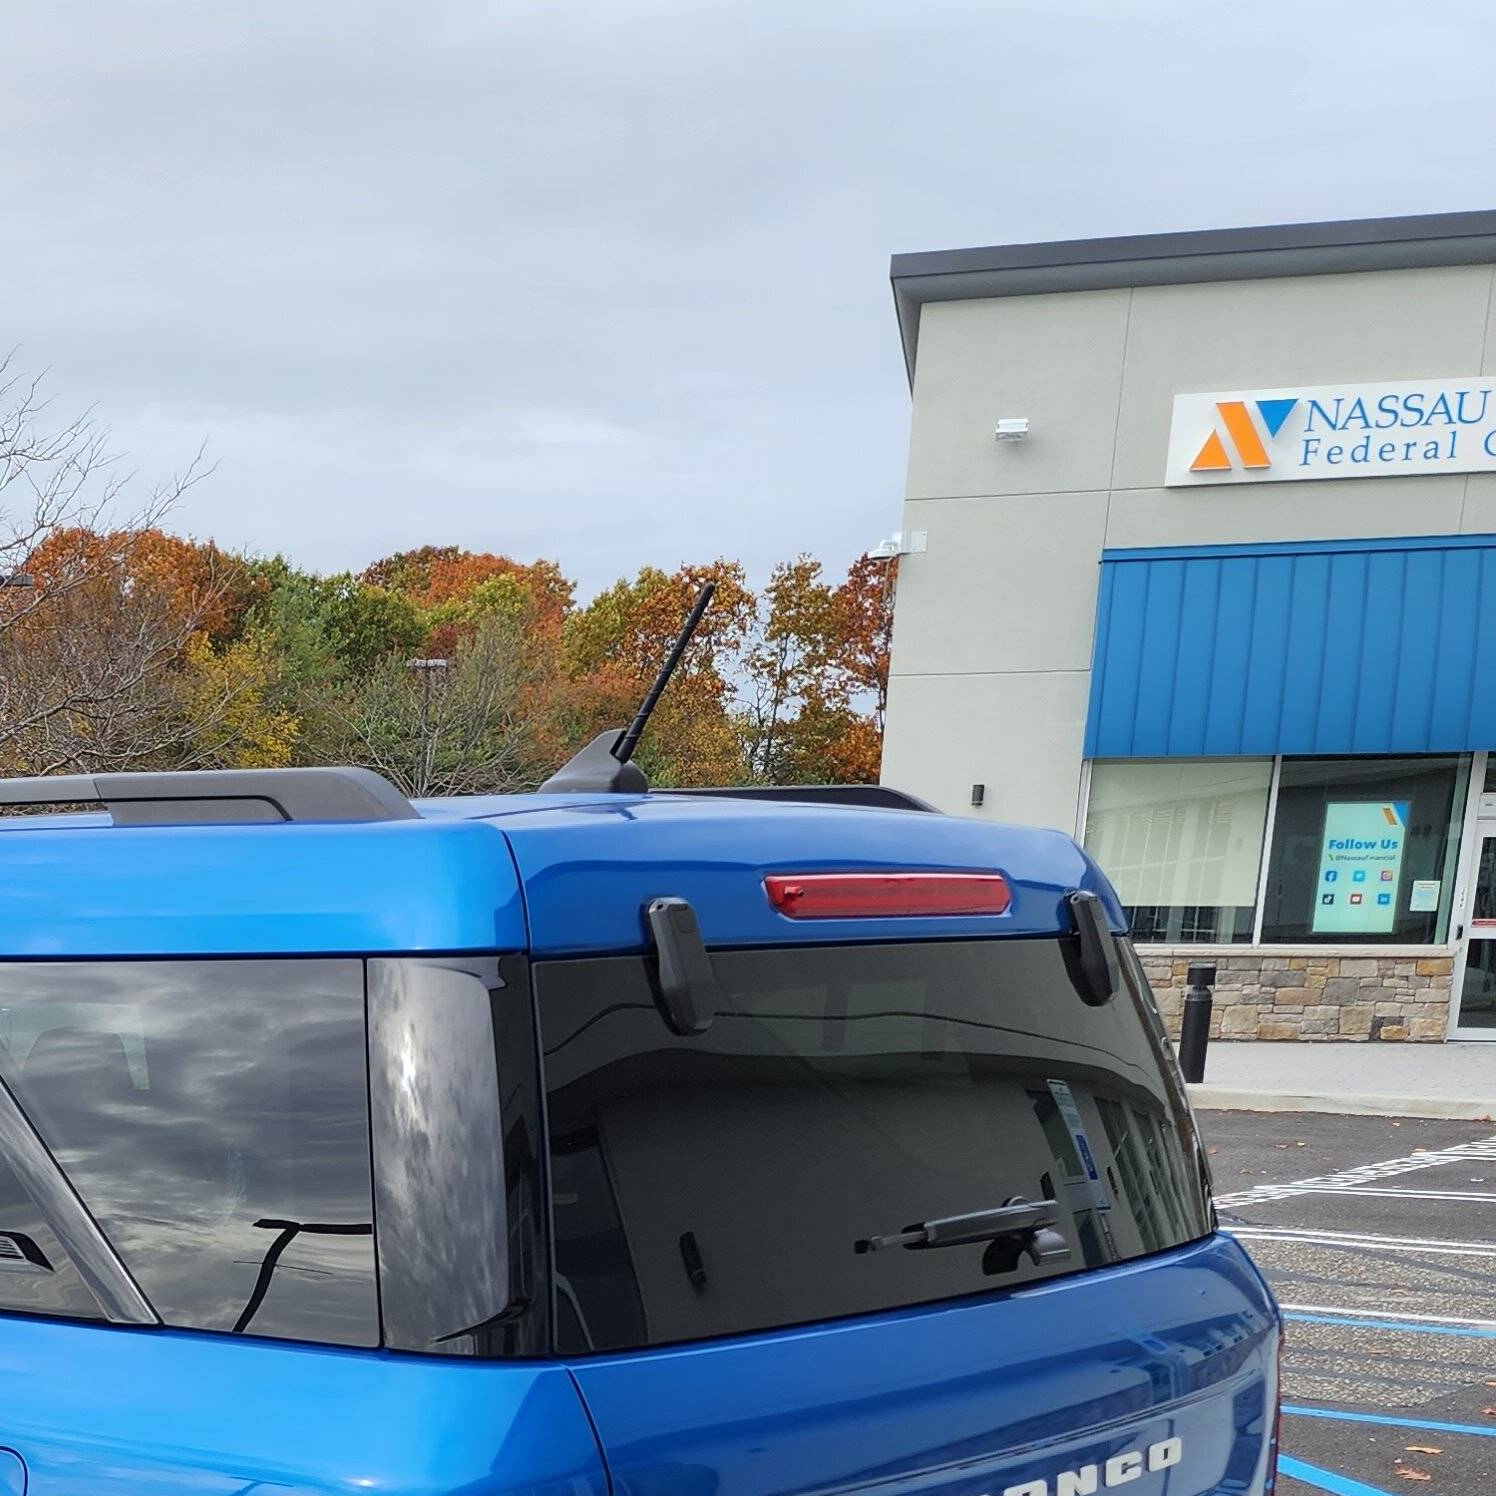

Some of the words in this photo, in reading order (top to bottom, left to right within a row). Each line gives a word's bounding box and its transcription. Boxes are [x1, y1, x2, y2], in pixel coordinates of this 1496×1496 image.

[1303, 389, 1492, 433] NASSAU
[1299, 431, 1457, 466] Federal
[1329, 839, 1377, 849] Follow
[1381, 839, 1399, 849] Us
